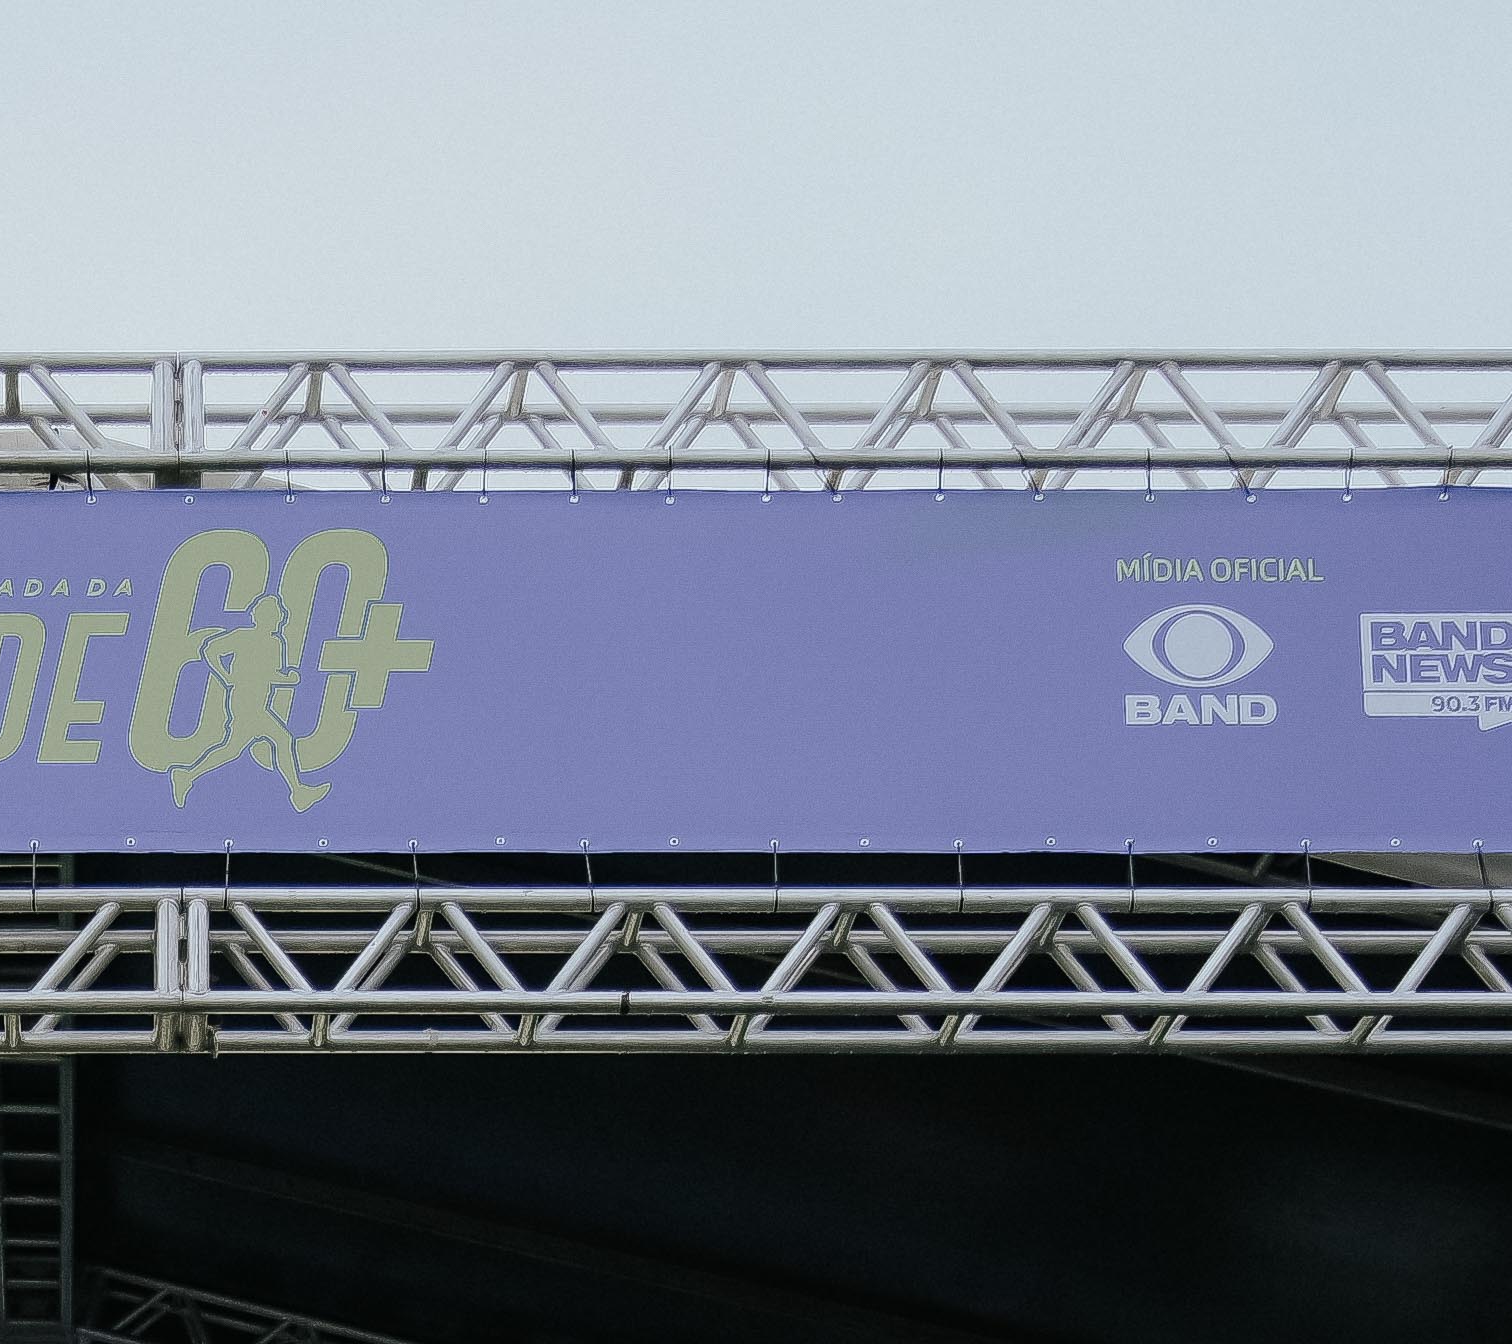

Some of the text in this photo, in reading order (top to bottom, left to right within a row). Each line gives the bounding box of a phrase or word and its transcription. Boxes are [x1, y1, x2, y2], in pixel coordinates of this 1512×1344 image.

[1115, 553, 1324, 583] MÍDIA OFICIAL
[86, 578, 134, 598] DA
[1124, 694, 1278, 727] BAND
[1431, 695, 1481, 714] 90.3
